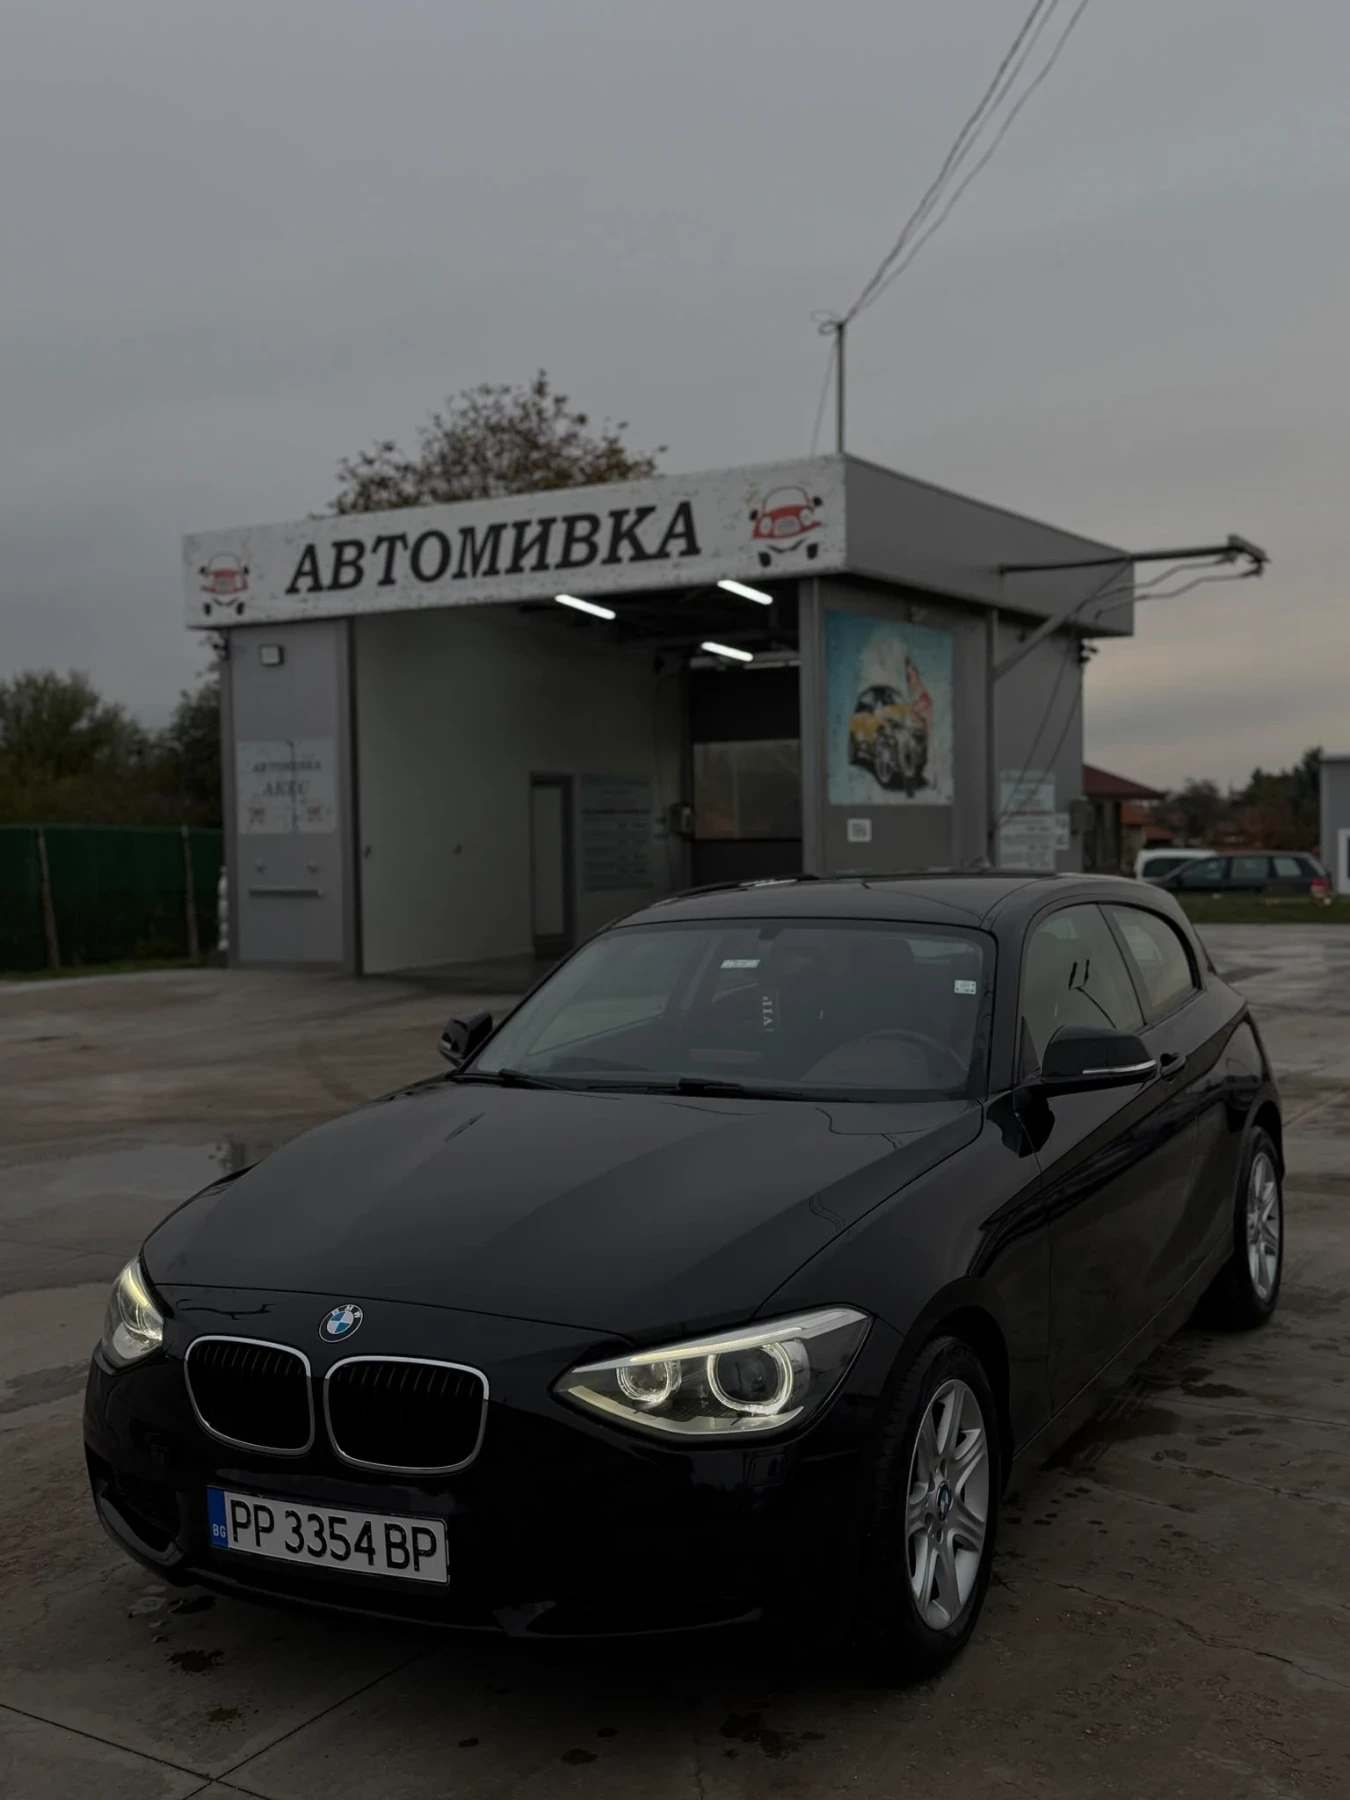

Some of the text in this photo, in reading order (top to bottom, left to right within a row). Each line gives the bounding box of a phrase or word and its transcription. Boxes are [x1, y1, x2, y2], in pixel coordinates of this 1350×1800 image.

[285, 501, 701, 594] АВТОМИВКА
[762, 996, 774, 1026] VIP
[331, 1305, 362, 1318] BMW
[213, 1523, 227, 1538] BG
[230, 1499, 437, 1571] PP 3354 BP
